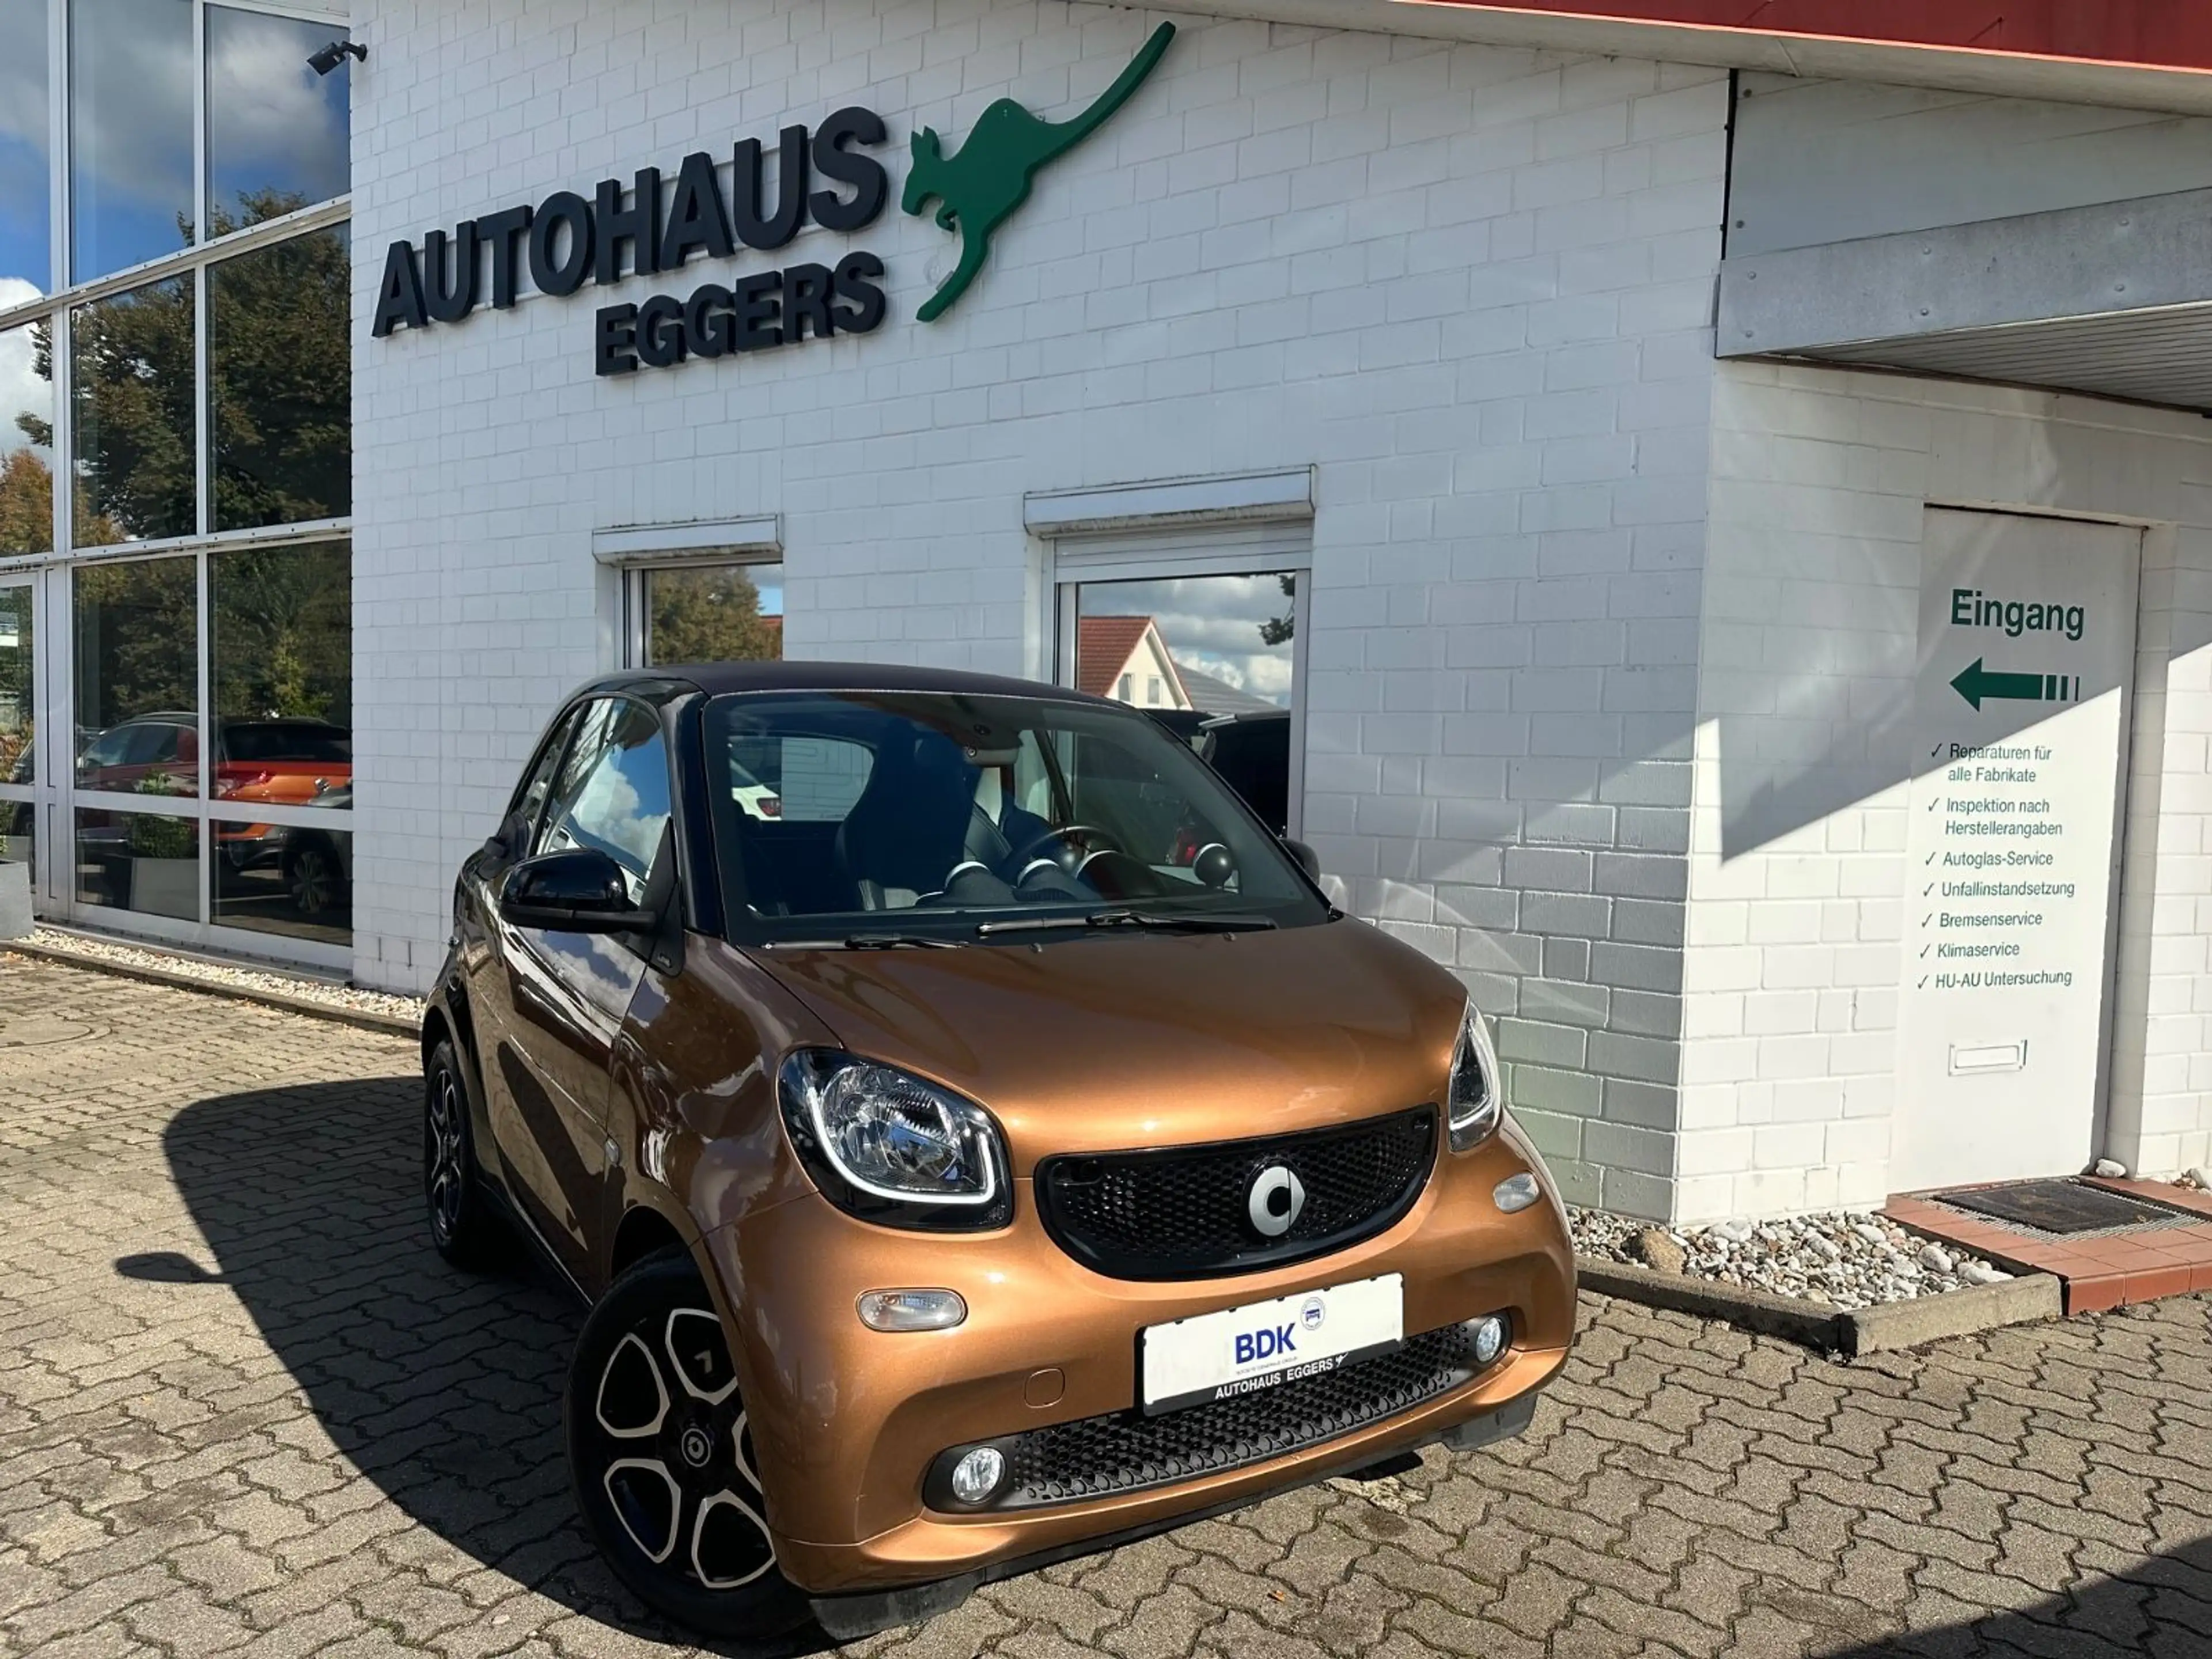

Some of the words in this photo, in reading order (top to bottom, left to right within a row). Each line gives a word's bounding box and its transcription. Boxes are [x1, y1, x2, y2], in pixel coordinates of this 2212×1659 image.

[372, 106, 889, 338] AUTOHAUS
[595, 251, 887, 376] EGGERS
[1951, 588, 2085, 641] Eingang
[1949, 743, 2031, 762] Reparaturen
[2034, 745, 2052, 760] für
[1948, 767, 1972, 782] alle
[1975, 767, 2036, 782] Fabrikate
[1946, 797, 2016, 815] Inspektion
[2019, 798, 2050, 813] nach
[1945, 820, 2063, 838] Herstellerangaben
[1942, 851, 2054, 869] Autoglas-Service
[1941, 881, 2075, 898] Unfallinstandsetzung
[1939, 911, 2043, 927] Bremsenservice
[1937, 942, 2020, 958] Klimaservice
[1935, 972, 1981, 988] HU-AU
[1984, 970, 2073, 987] Untersuchung
[1236, 1323, 1296, 1364] BDK
[1214, 1372, 1281, 1400] AUTOHAUS
[1286, 1358, 1334, 1381] EGGERS
